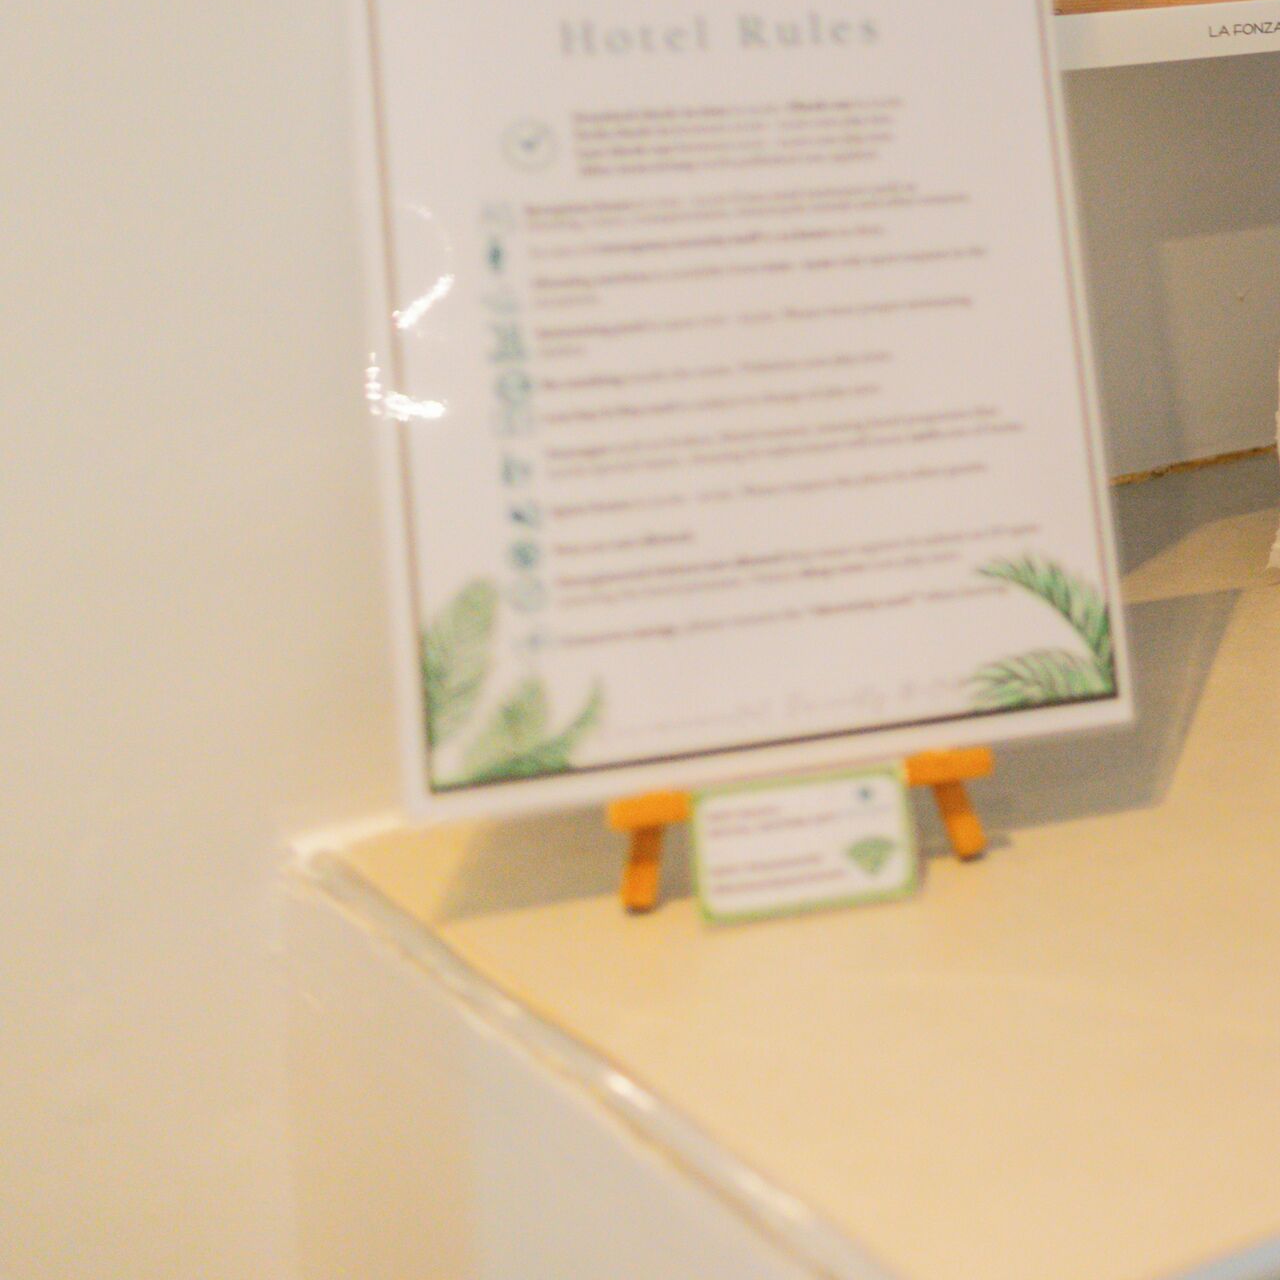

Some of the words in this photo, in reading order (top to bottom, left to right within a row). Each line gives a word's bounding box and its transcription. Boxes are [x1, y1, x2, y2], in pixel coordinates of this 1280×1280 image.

[558, 17, 711, 58] Hotel
[736, 10, 880, 48] Rules
[1208, 25, 1231, 38] LA
